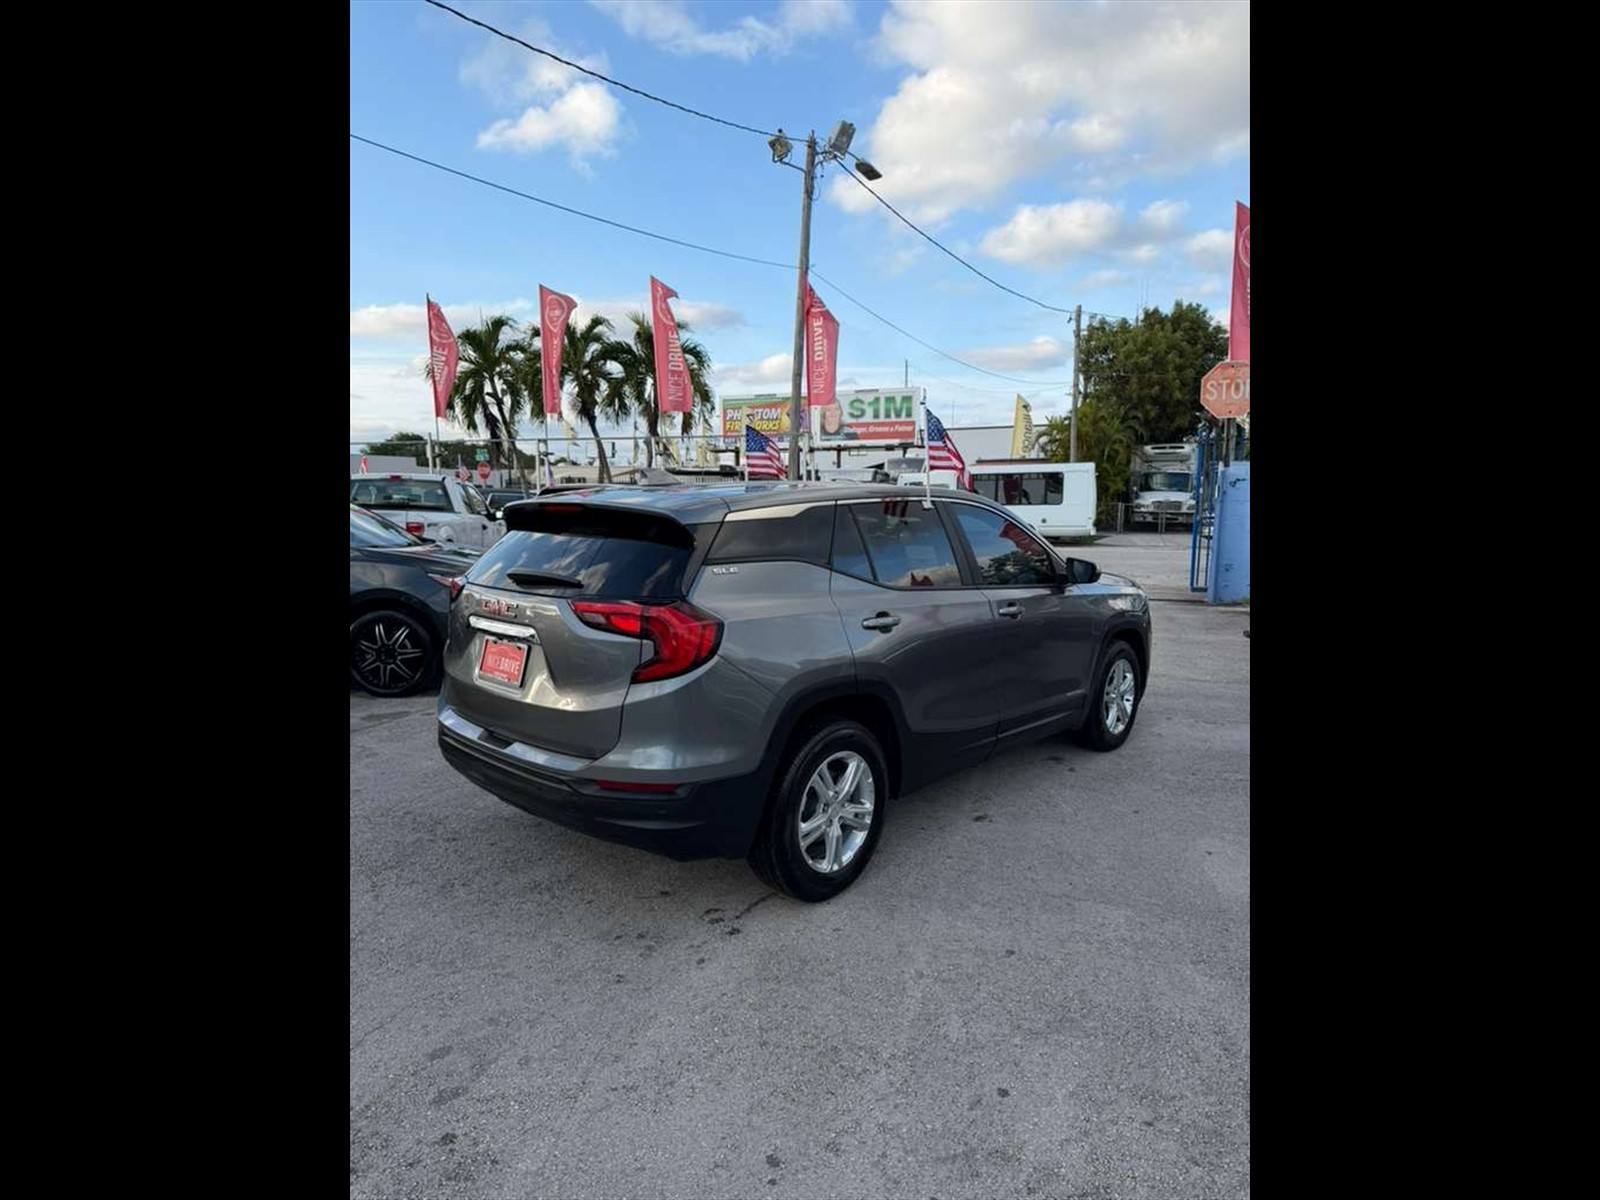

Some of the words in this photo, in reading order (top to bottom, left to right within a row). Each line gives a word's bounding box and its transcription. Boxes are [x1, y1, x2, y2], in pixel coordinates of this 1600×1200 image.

[668, 330, 684, 371] DRIVE
[813, 316, 824, 362] DRIVE
[668, 373, 684, 401] NICE
[812, 364, 825, 395] NICE
[726, 407, 781, 420] PHTOM
[848, 395, 913, 419] $1M
[725, 420, 780, 432] FIRORKS
[481, 599, 519, 618] GMC
[499, 656, 521, 677] DRIVE
